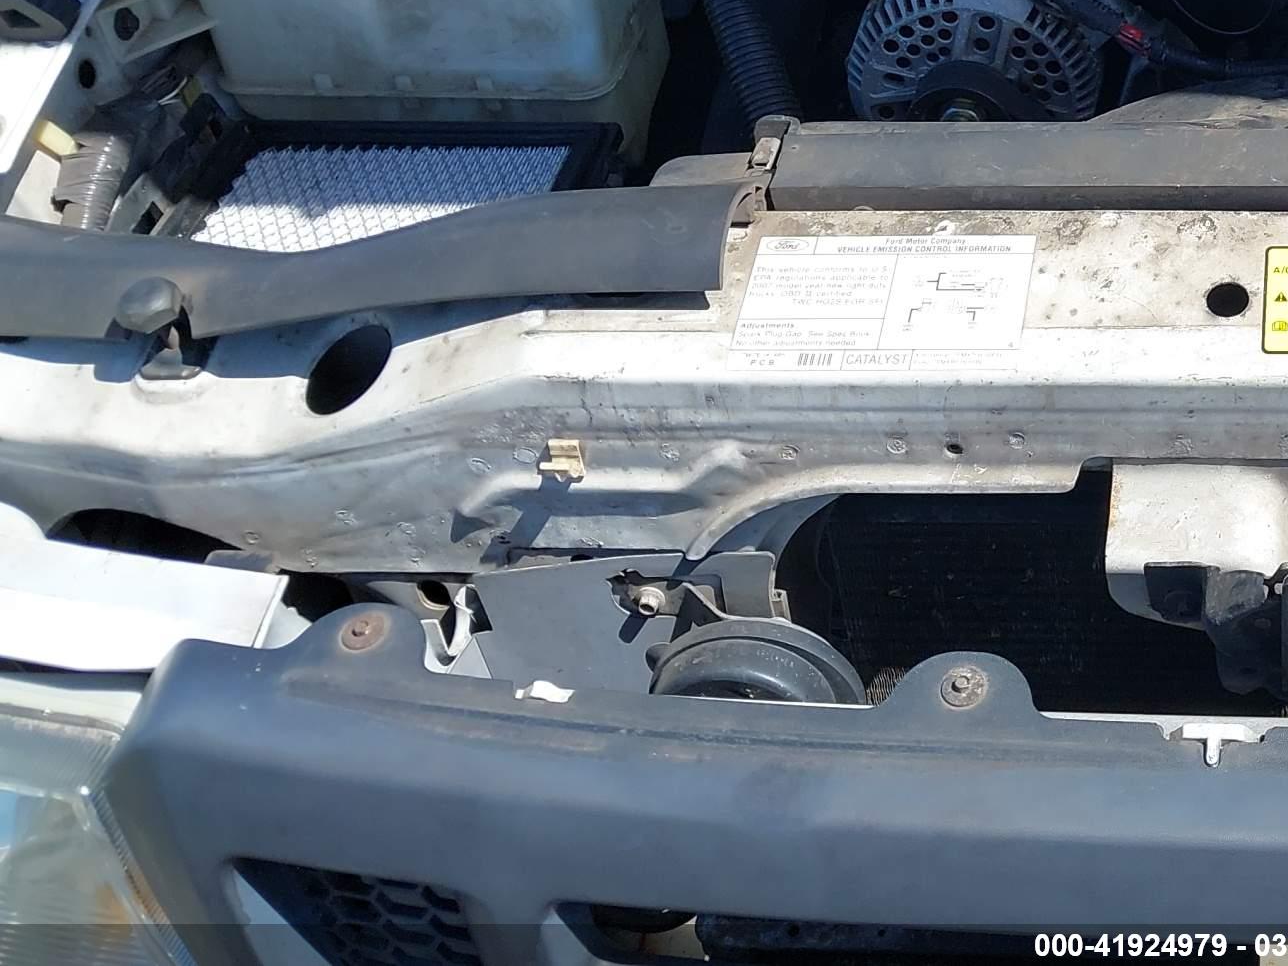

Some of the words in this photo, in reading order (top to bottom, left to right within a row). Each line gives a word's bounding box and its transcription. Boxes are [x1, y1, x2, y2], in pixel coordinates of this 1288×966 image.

[774, 240, 801, 250] Ford
[886, 237, 903, 245] Ford
[906, 237, 928, 245] Motor
[930, 237, 966, 245] Company
[740, 322, 795, 330] Adjustments
[845, 353, 908, 365] CATALYST
